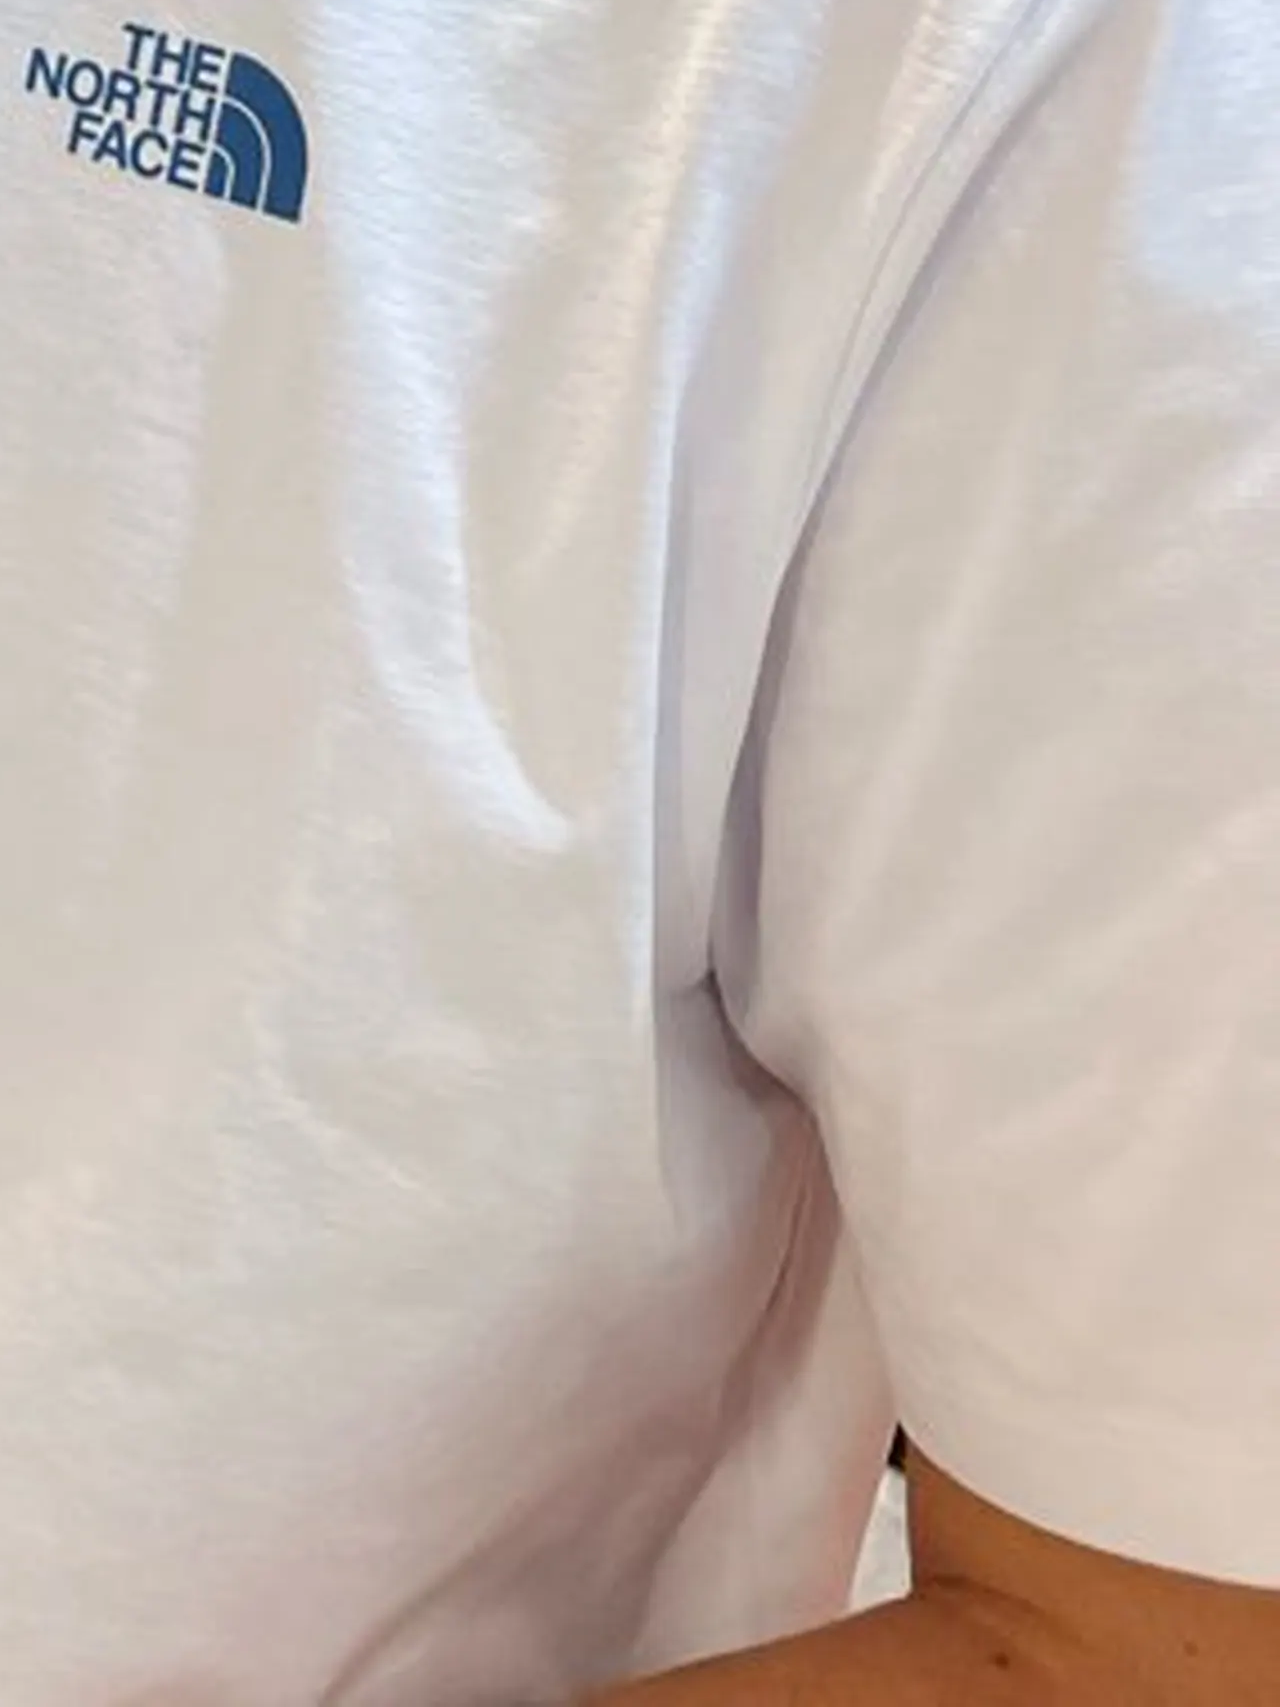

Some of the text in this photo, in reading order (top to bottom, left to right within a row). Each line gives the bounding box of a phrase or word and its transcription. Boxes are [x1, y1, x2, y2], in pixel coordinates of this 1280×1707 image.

[25, 48, 215, 142] NORTH
[122, 22, 225, 93] THE
[67, 111, 204, 191] FACE
